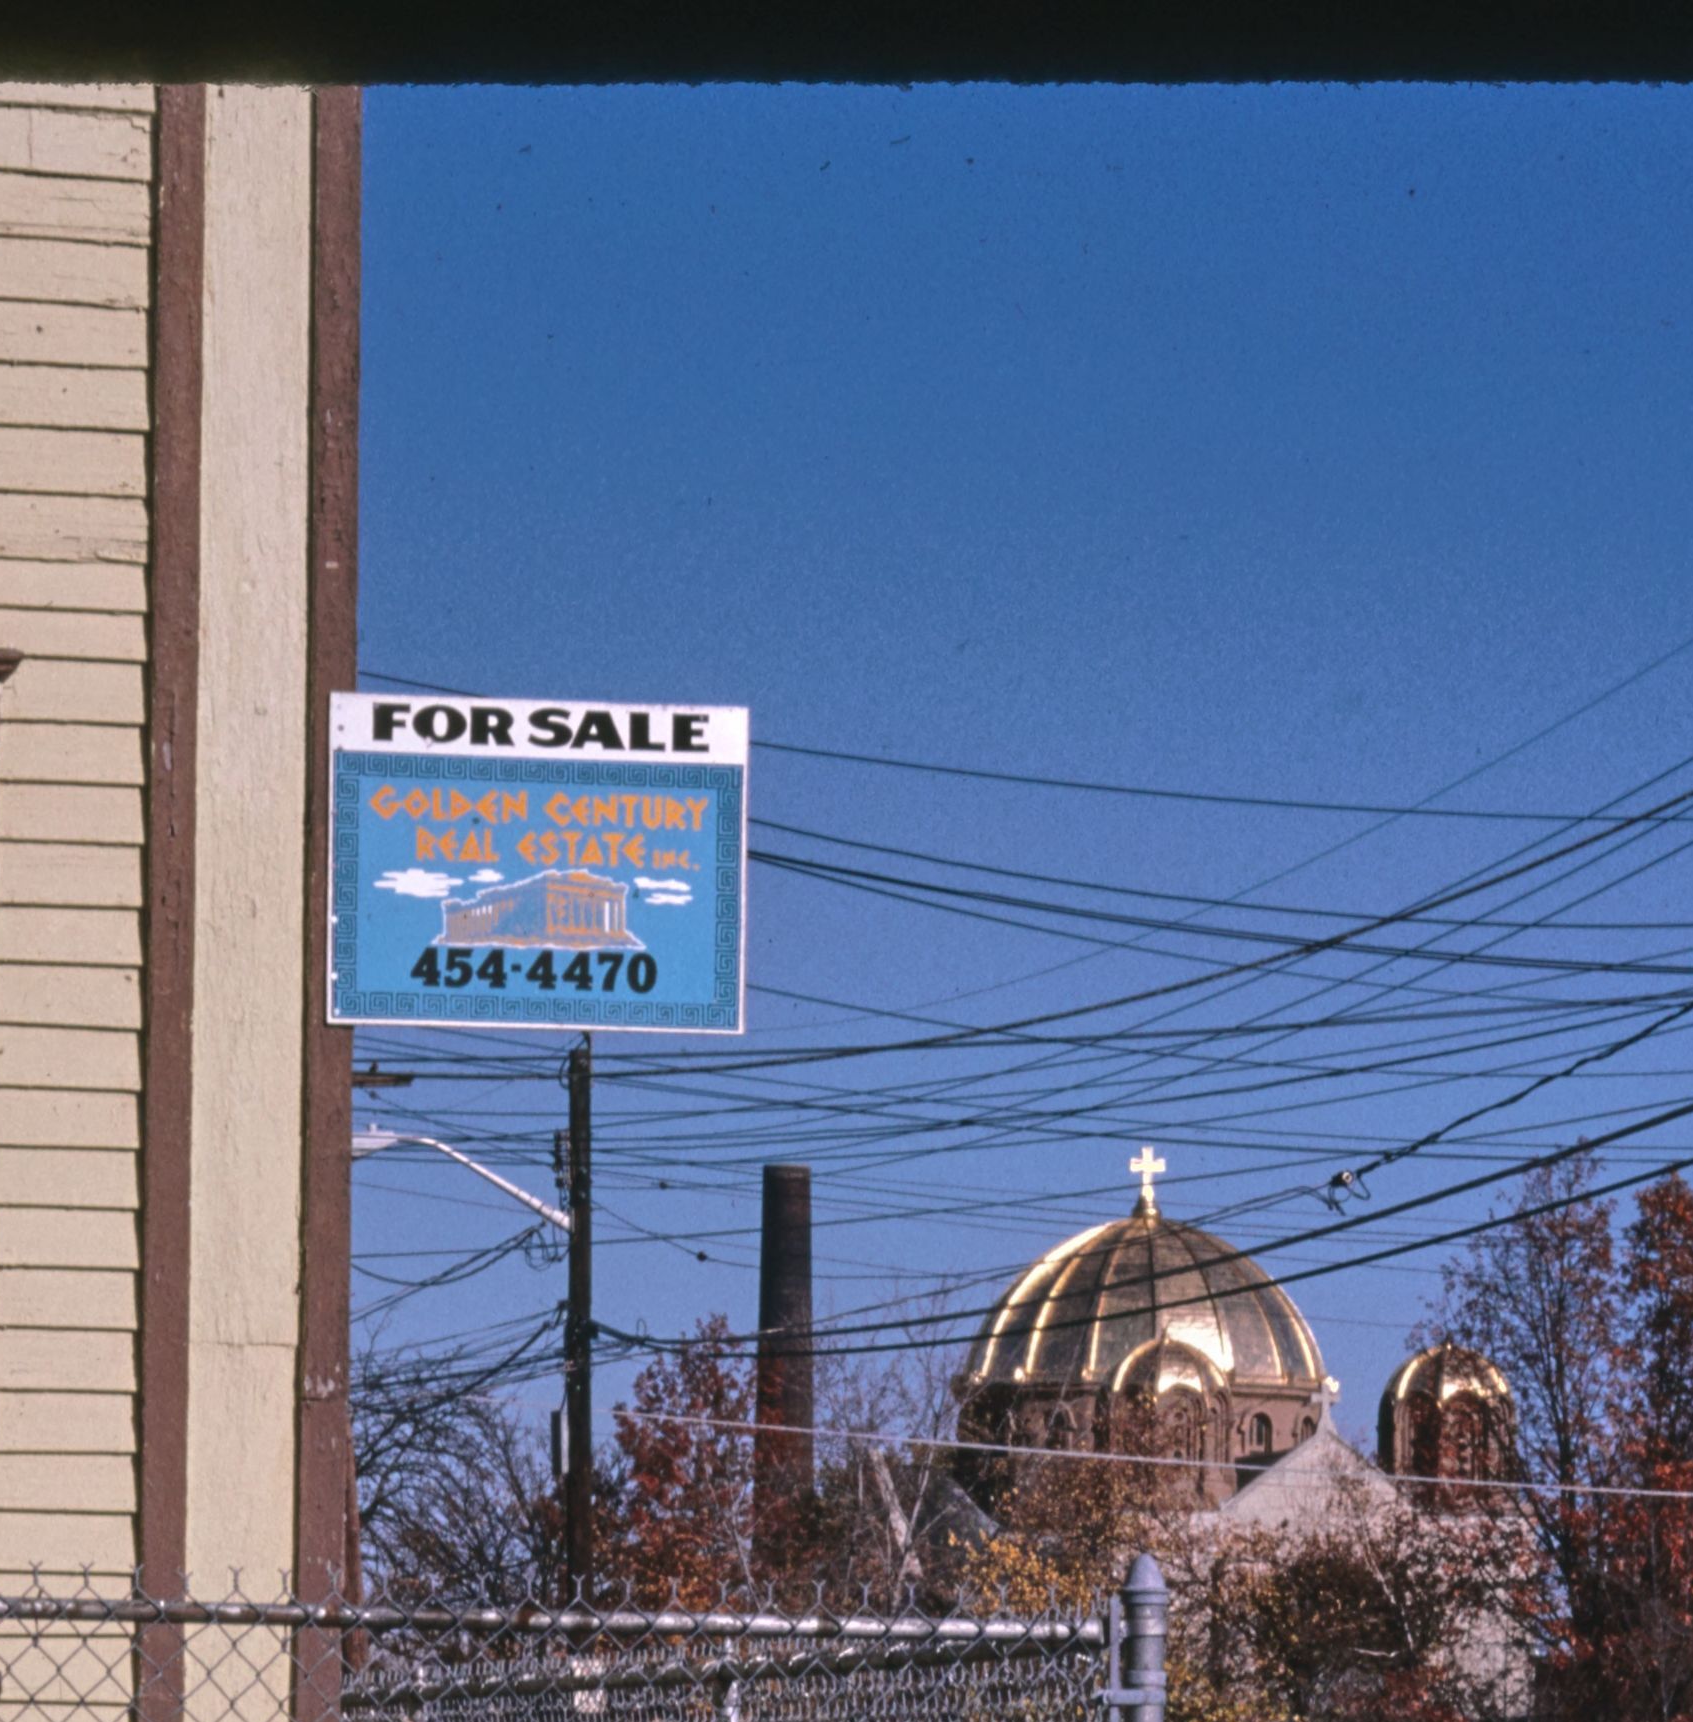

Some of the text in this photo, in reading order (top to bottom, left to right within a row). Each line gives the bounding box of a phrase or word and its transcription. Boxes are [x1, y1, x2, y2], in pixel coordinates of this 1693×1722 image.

[372, 702, 710, 753] FOR SALE
[370, 784, 709, 831] GOLDEN CENTURY
[415, 826, 500, 862] REAL
[517, 831, 645, 869] ESTATE
[410, 946, 657, 994] 454-4470
